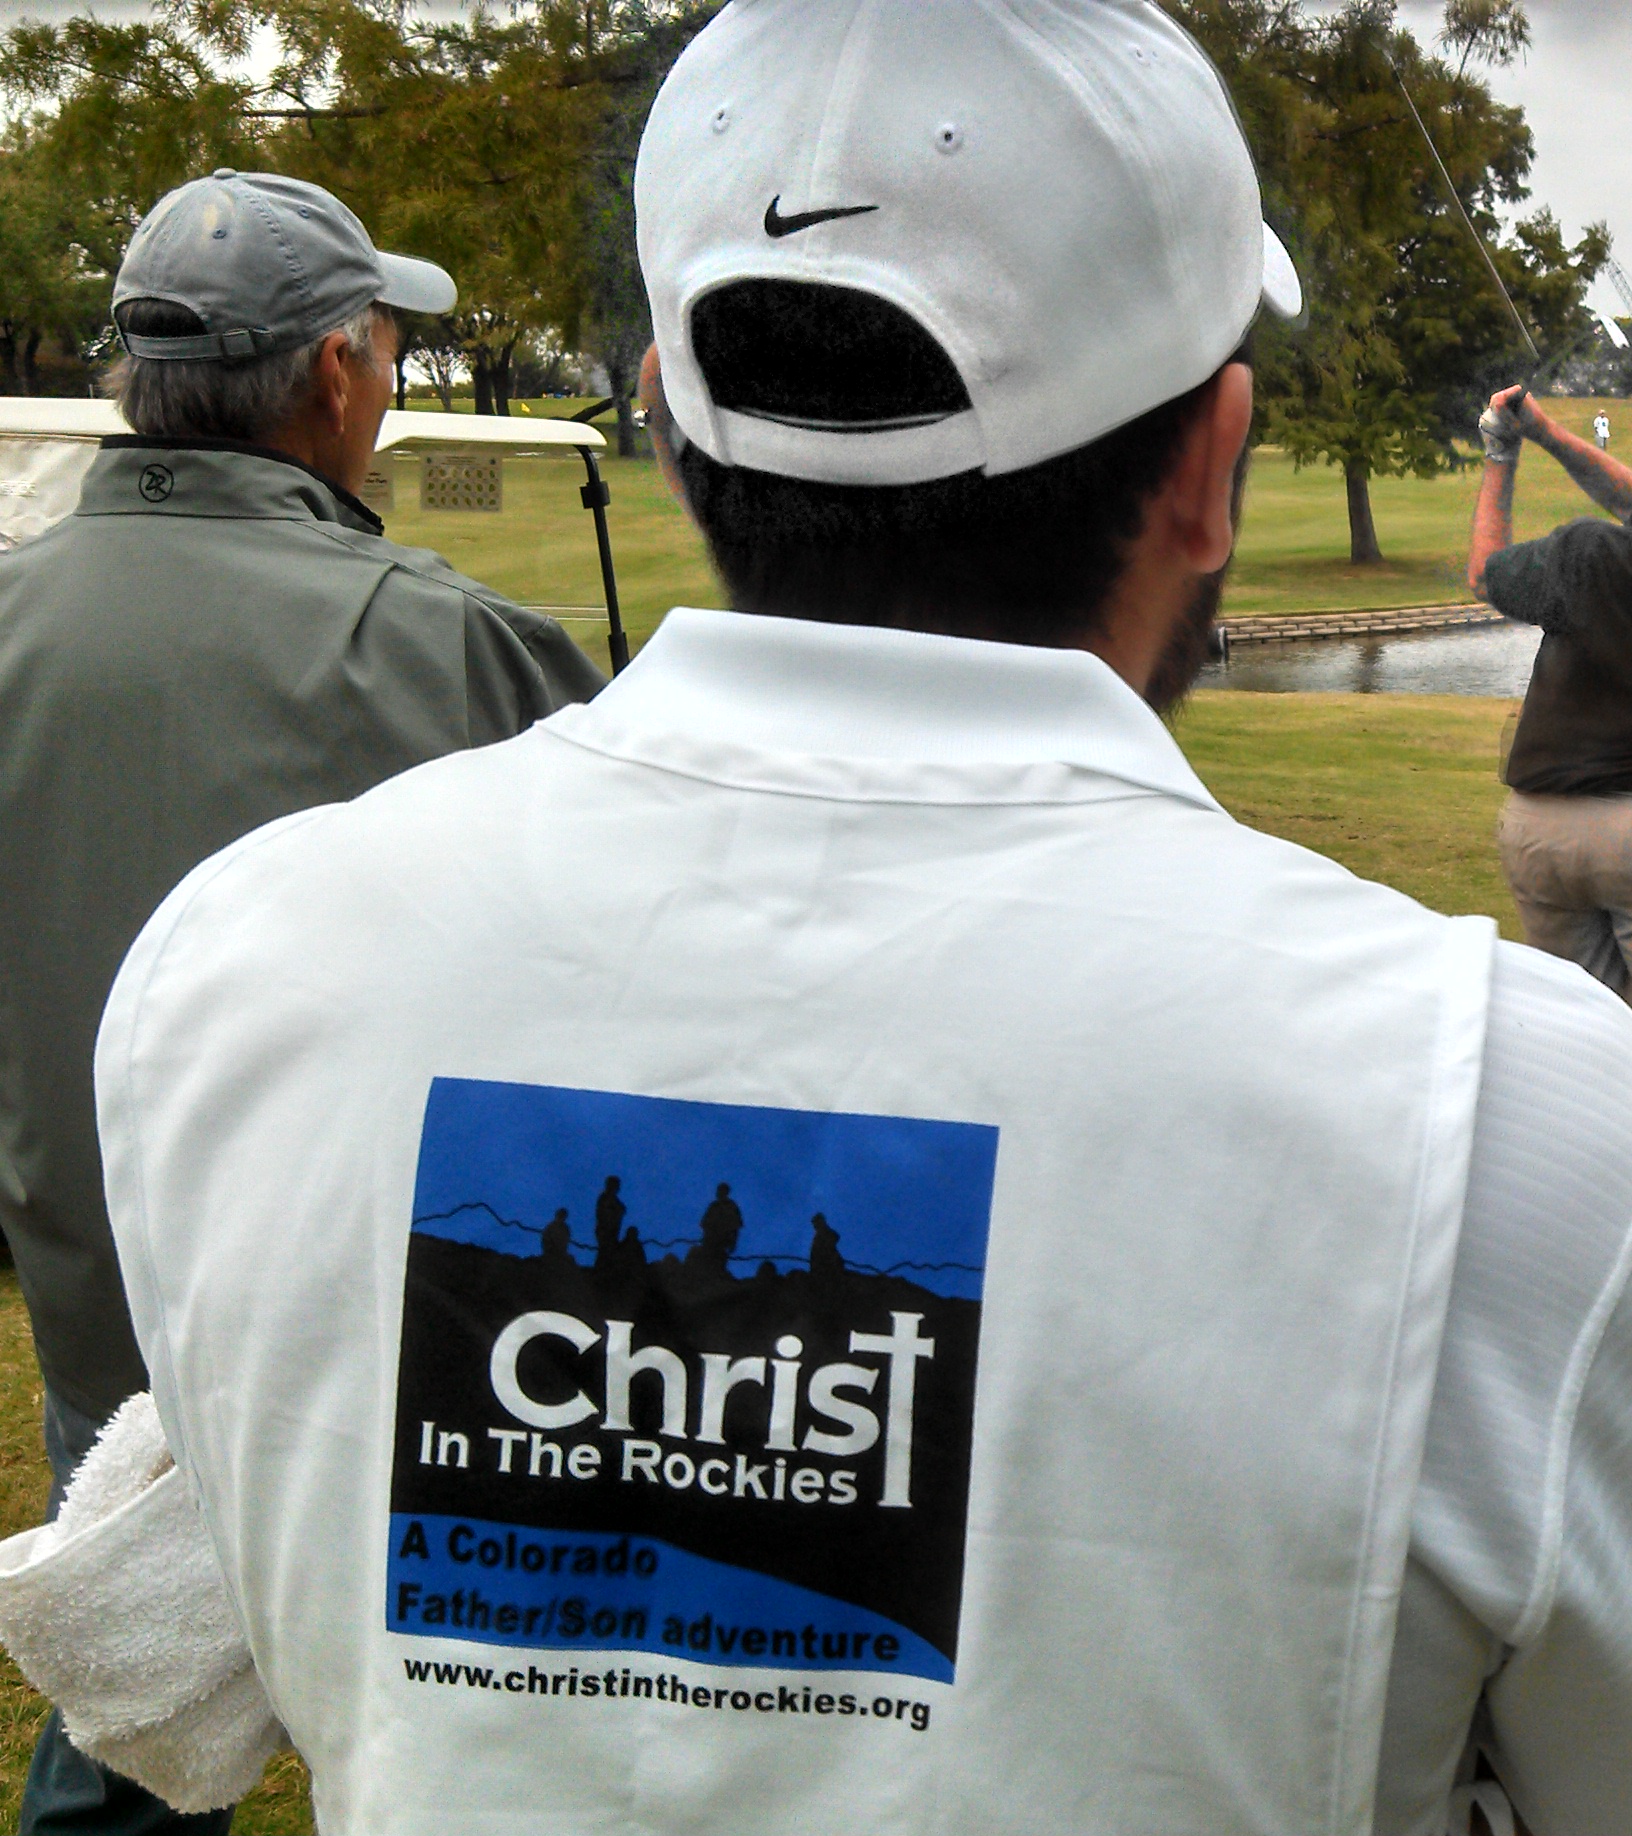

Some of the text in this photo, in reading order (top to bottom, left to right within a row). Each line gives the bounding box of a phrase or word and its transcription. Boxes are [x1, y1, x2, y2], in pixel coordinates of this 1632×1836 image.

[490, 1309, 935, 1507] Christ
[419, 1421, 858, 1505] In The Rockies
[399, 1522, 658, 1577] A Colorado
[395, 1583, 901, 1662] Father/Son adventure
[404, 1658, 932, 1732] www.christintherockies.org
